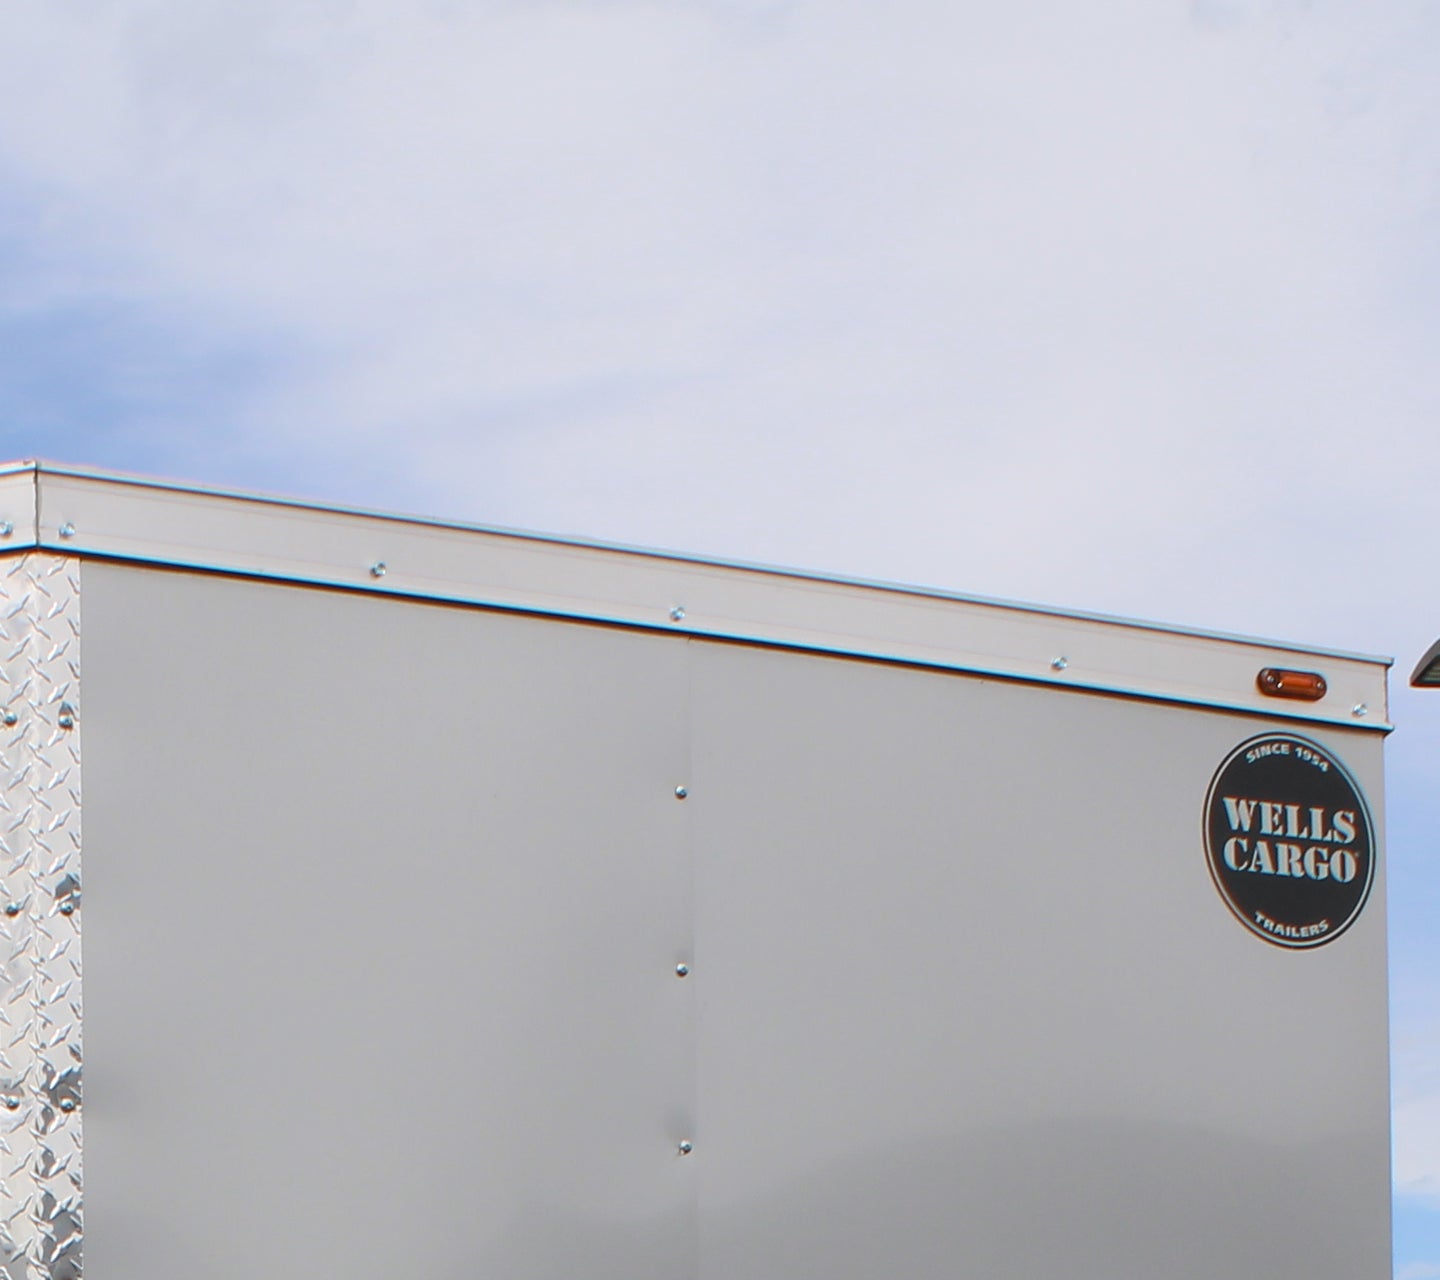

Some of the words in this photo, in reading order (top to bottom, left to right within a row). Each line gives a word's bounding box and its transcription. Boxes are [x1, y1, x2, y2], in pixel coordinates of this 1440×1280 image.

[1246, 743, 1290, 764] SINCE
[1295, 747, 1329, 773] 1954
[1223, 797, 1356, 844] WELLS
[1223, 837, 1357, 883] CARGO
[1254, 910, 1329, 938] TRAILERS
